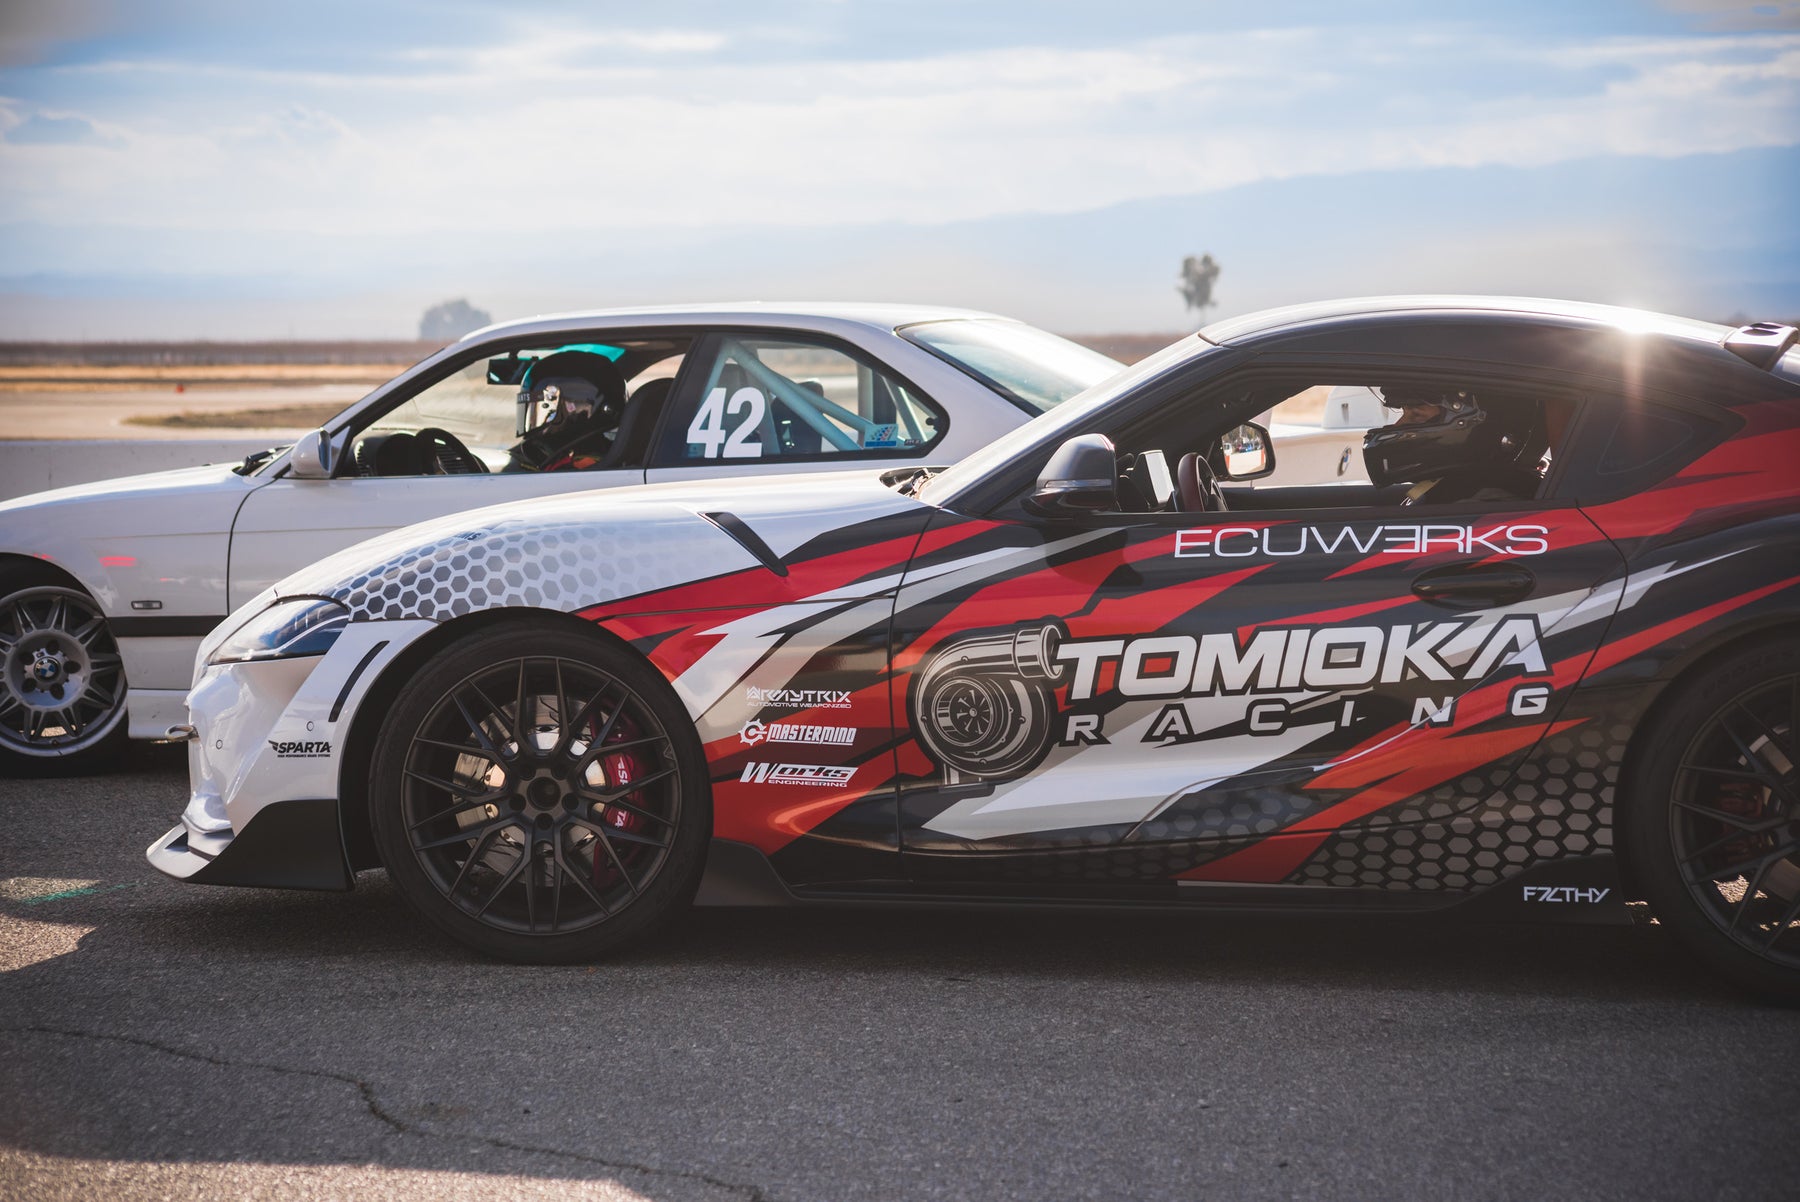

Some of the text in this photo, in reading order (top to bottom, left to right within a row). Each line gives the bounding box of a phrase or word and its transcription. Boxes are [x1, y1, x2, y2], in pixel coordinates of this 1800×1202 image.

[686, 386, 766, 459] 42
[1173, 524, 1549, 559] ECUWERKS
[1056, 618, 1547, 701] TOMIOKA
[746, 685, 852, 703] ARMYTRIX
[1065, 686, 1549, 742] RACING
[765, 723, 858, 746] MASTERMIND
[277, 740, 333, 754] SPARTA
[739, 761, 859, 784] Works
[767, 779, 849, 788] ENGINEERING
